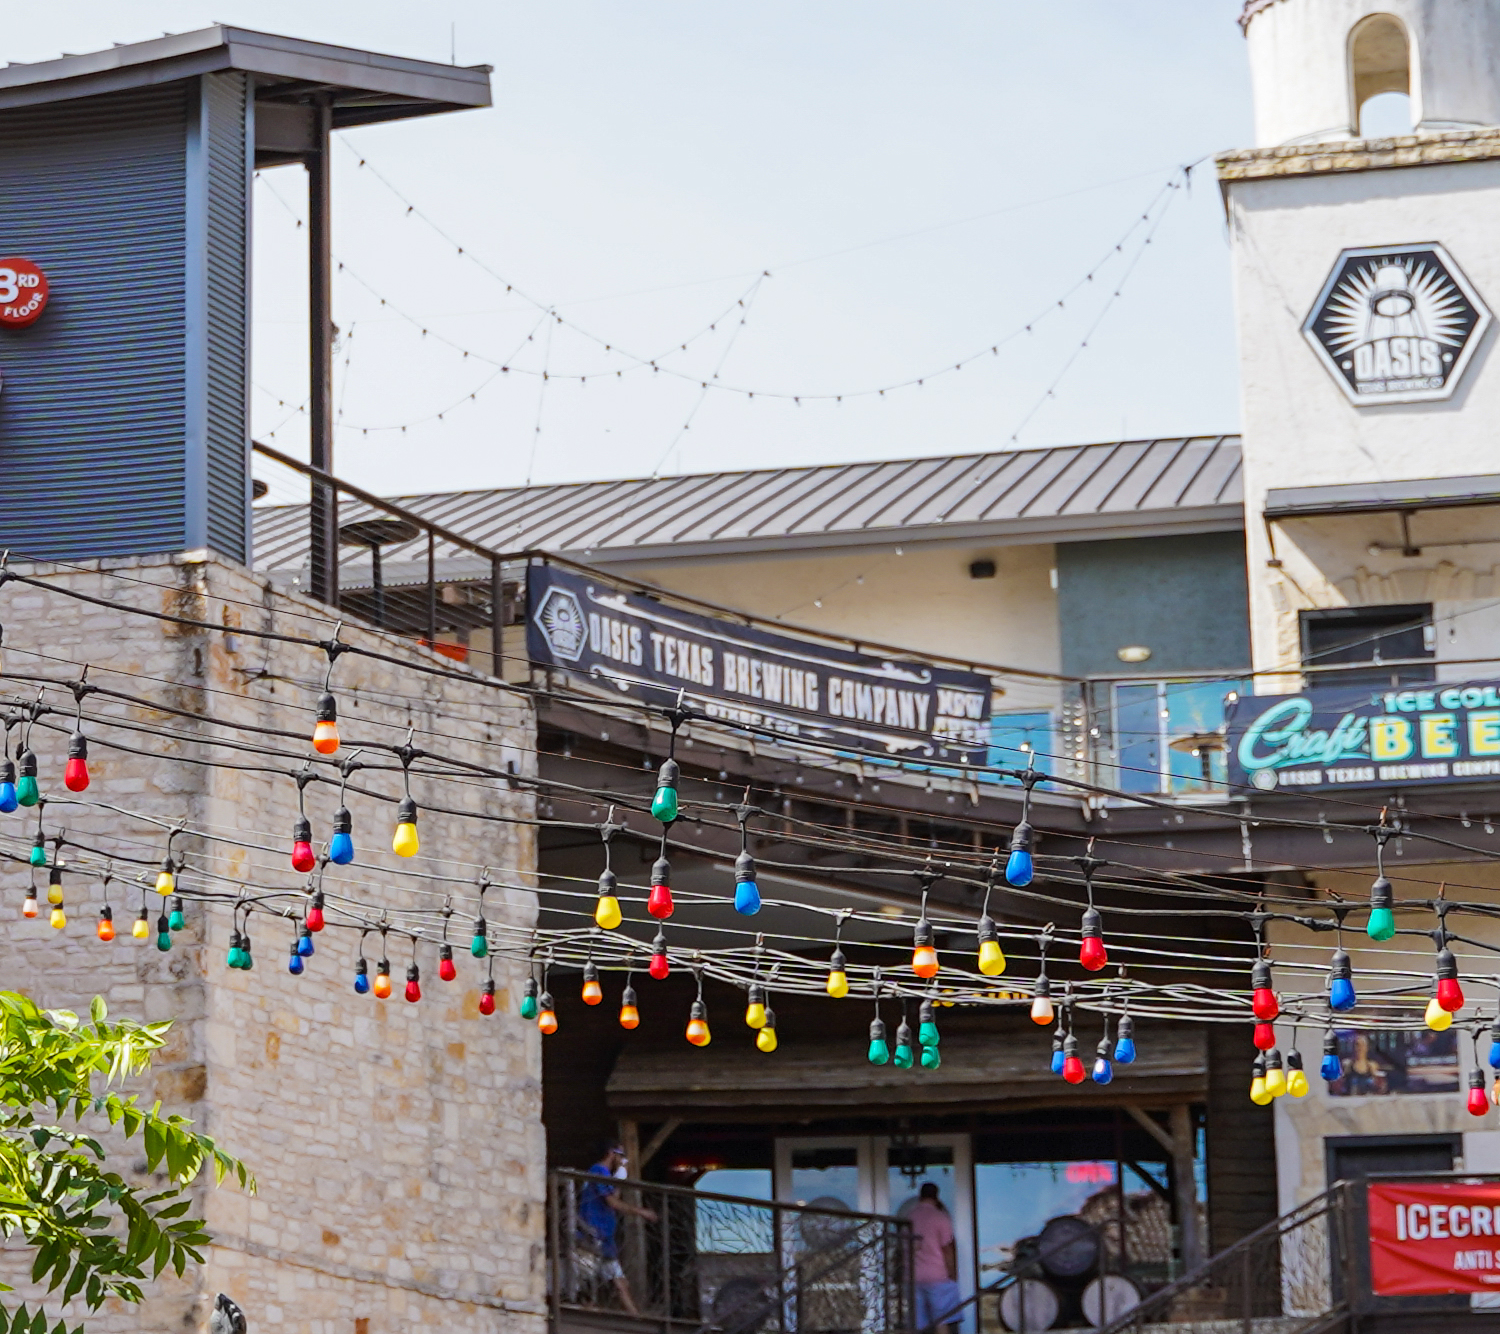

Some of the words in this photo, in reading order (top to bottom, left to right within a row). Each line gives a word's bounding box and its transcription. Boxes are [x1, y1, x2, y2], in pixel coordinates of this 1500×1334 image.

[3, 292, 44, 318] FLOOR
[1354, 337, 1443, 381] OASIS
[588, 612, 643, 667] OASIS
[650, 631, 714, 687] TEXAS
[723, 652, 819, 712] BREWING
[827, 677, 931, 732] COMPANY
[936, 688, 985, 720] NOW
[1383, 691, 1436, 713] ICE
[1238, 697, 1370, 771] Craft
[1325, 766, 1376, 783] TEXAS
[1453, 1249, 1493, 1271] ANTI
